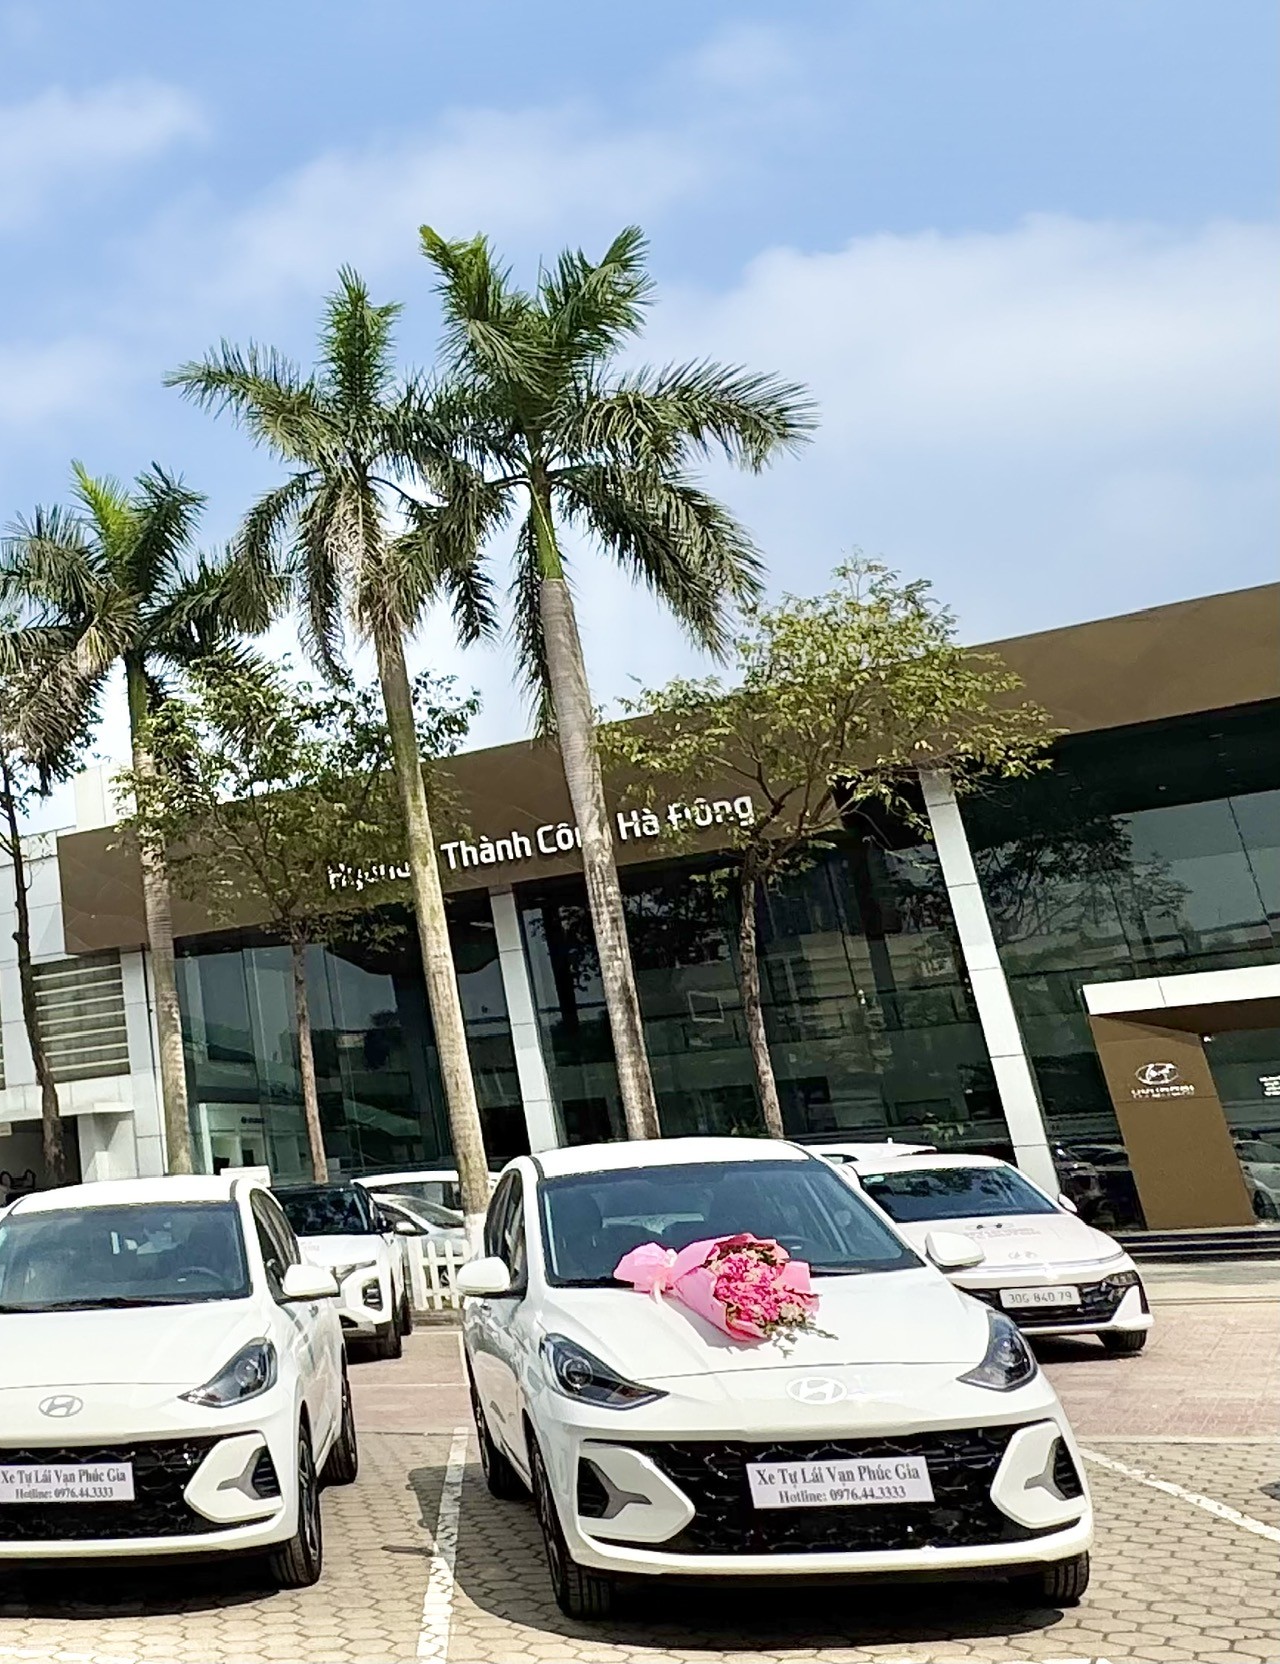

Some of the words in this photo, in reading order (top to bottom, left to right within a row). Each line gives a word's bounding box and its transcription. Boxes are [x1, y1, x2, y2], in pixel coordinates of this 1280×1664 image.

[440, 831, 532, 870] Thành
[536, 822, 584, 854] Cô
[617, 808, 660, 841] Hà
[1, 1469, 15, 1484] Xe
[16, 1469, 33, 1487] Tự
[34, 1468, 52, 1484] Lái
[55, 1469, 76, 1486] Vạn
[78, 1466, 105, 1483] Phúc
[107, 1467, 126, 1482] Gia
[755, 1469, 776, 1486] Xe
[777, 1468, 798, 1488] Tự
[801, 1466, 824, 1484] Lái
[826, 1465, 855, 1487] Vạn
[857, 1463, 893, 1482] Phúc
[894, 1462, 921, 1480] Gia
[15, 1488, 53, 1500] Hotline:
[53, 1487, 114, 1499] 0976.44.3333
[778, 1490, 827, 1504] Hotline:
[829, 1485, 907, 1501] 0976.44.3333
